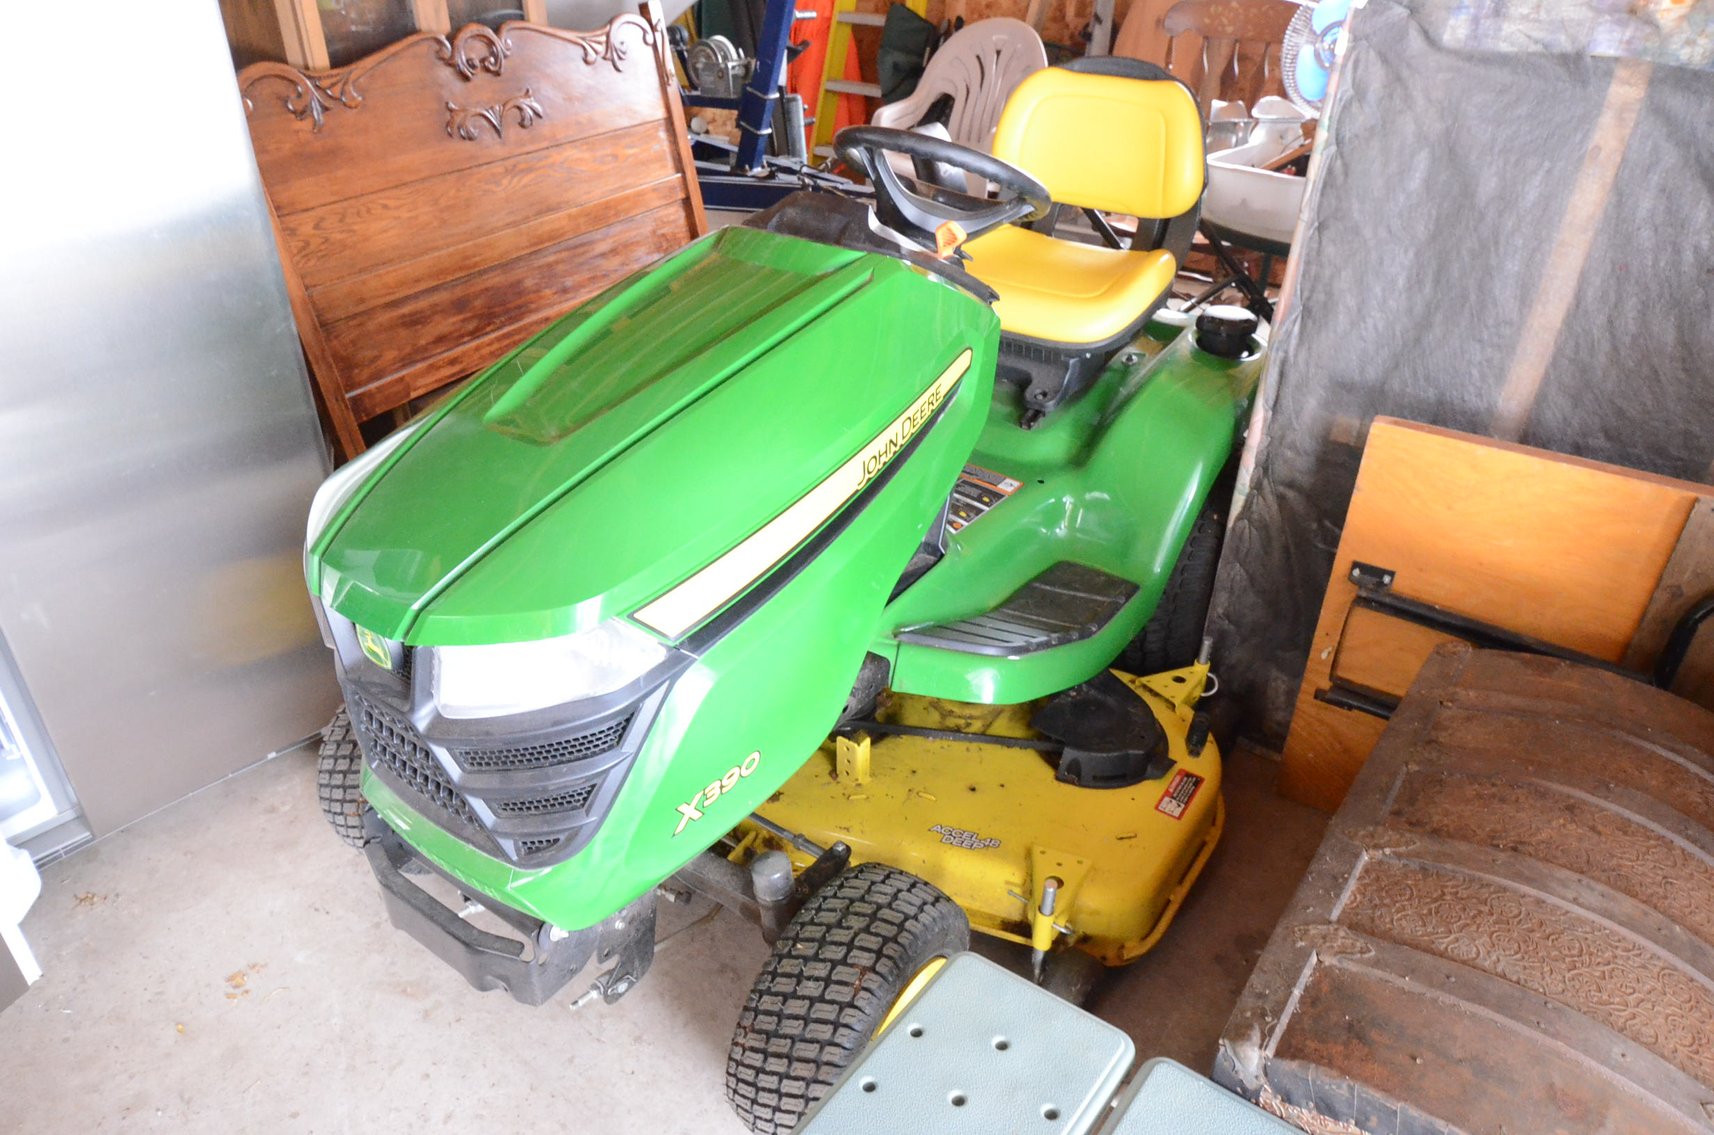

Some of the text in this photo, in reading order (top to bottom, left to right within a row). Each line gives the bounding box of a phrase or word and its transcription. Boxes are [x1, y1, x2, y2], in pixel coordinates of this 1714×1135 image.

[857, 383, 942, 487] JOHN DEERE
[671, 750, 761, 838] X390
[929, 824, 980, 843] ACCEL
[941, 834, 985, 850] DEEP
